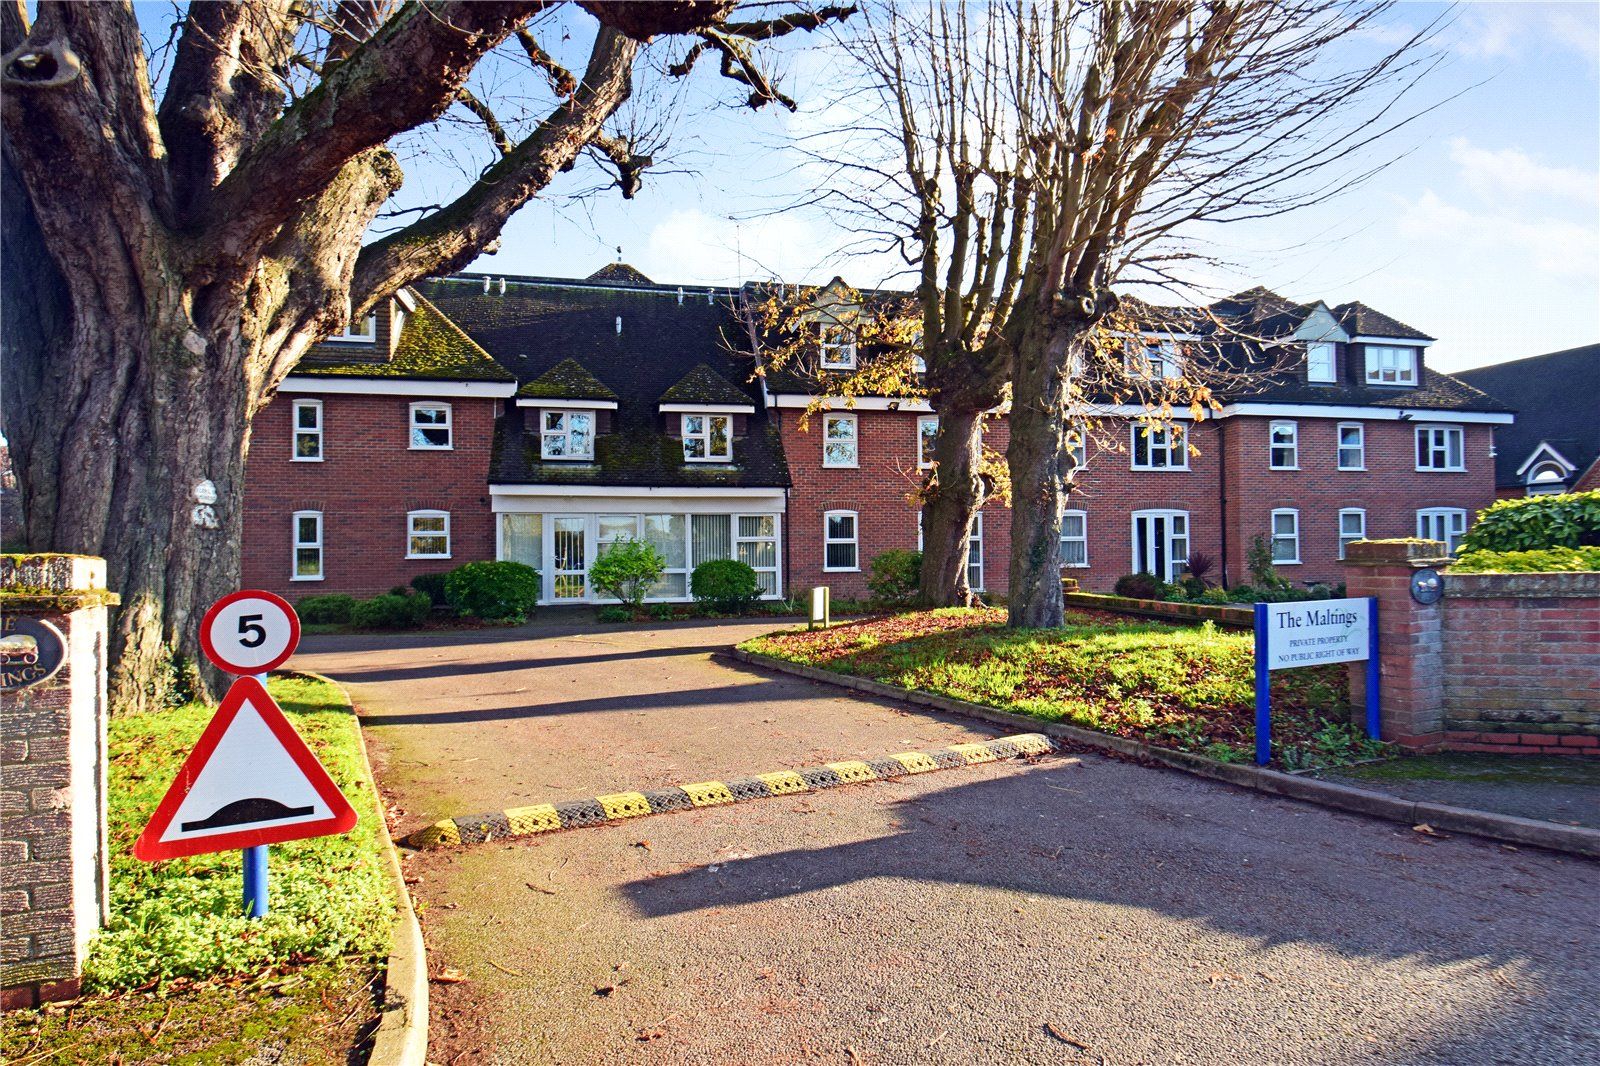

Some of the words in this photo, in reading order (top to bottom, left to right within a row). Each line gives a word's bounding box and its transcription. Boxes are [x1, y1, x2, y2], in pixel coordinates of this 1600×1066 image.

[1276, 611, 1302, 628] The
[1306, 609, 1357, 628] Maltings
[238, 613, 267, 648] 5
[1289, 637, 1316, 647] PRIVATE
[1317, 635, 1347, 645] PROPERTY
[1278, 654, 1289, 662] NO
[1291, 651, 1314, 661] PUBLIC
[1315, 650, 1335, 659] RIGHT
[1336, 648, 1345, 656] OF
[1346, 647, 1359, 655] WAY
[0, 665, 46, 687] INGS
